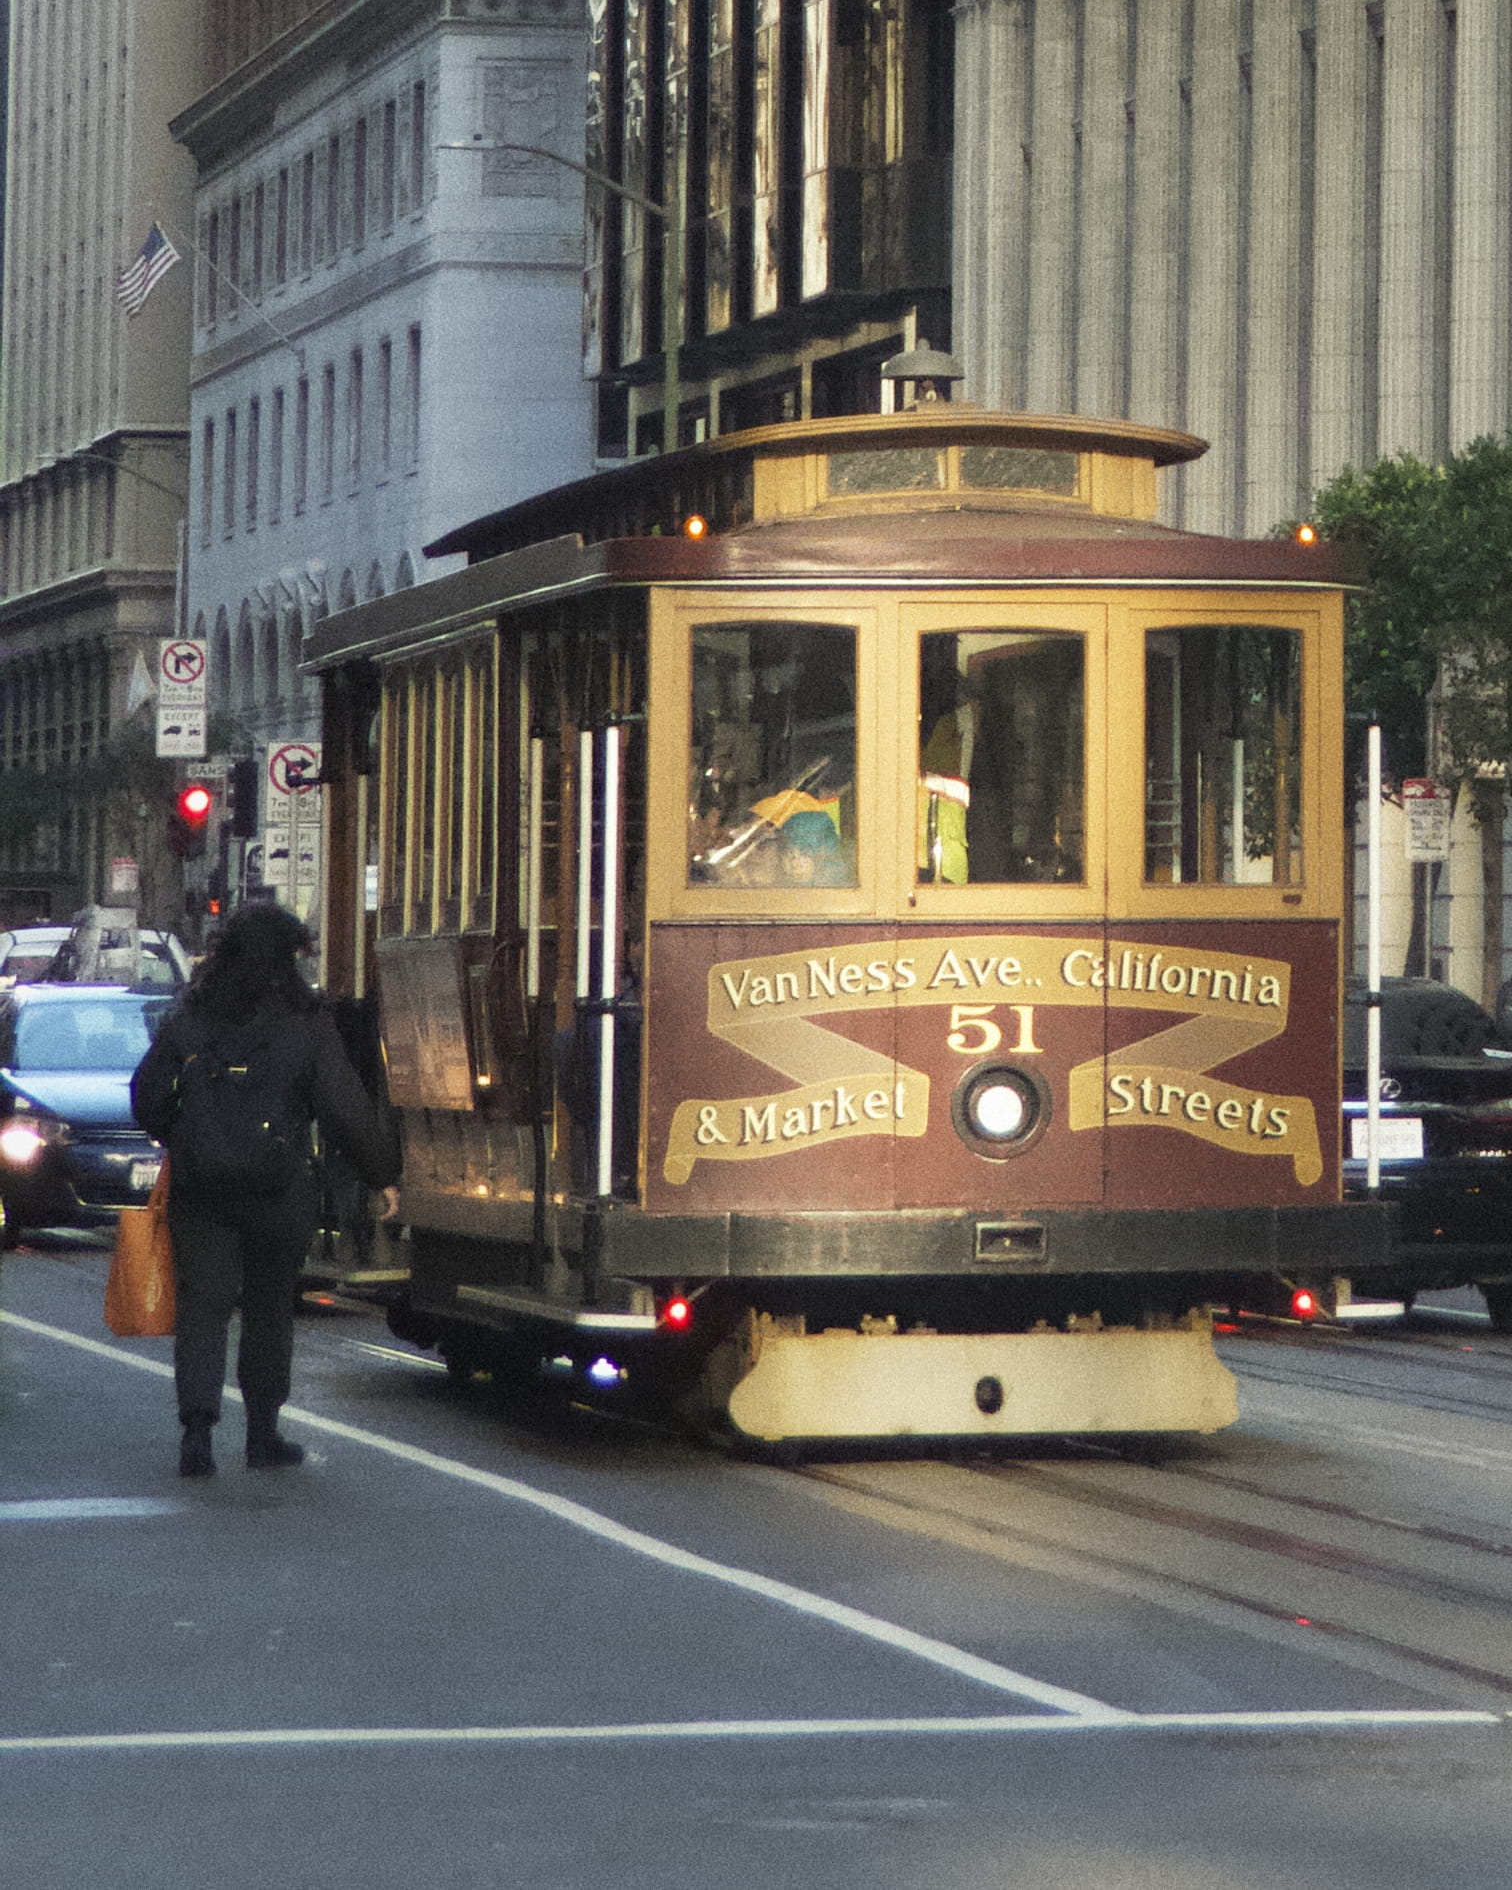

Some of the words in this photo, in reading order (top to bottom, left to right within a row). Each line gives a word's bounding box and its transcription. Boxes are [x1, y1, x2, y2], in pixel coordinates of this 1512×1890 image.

[722, 969, 800, 1009] Van
[807, 956, 917, 996] Ness
[1062, 949, 1281, 1007] California
[947, 1005, 1044, 1055] 51
[697, 1105, 729, 1145] &
[740, 1081, 906, 1144] Market
[1107, 1074, 1291, 1137] Streets
